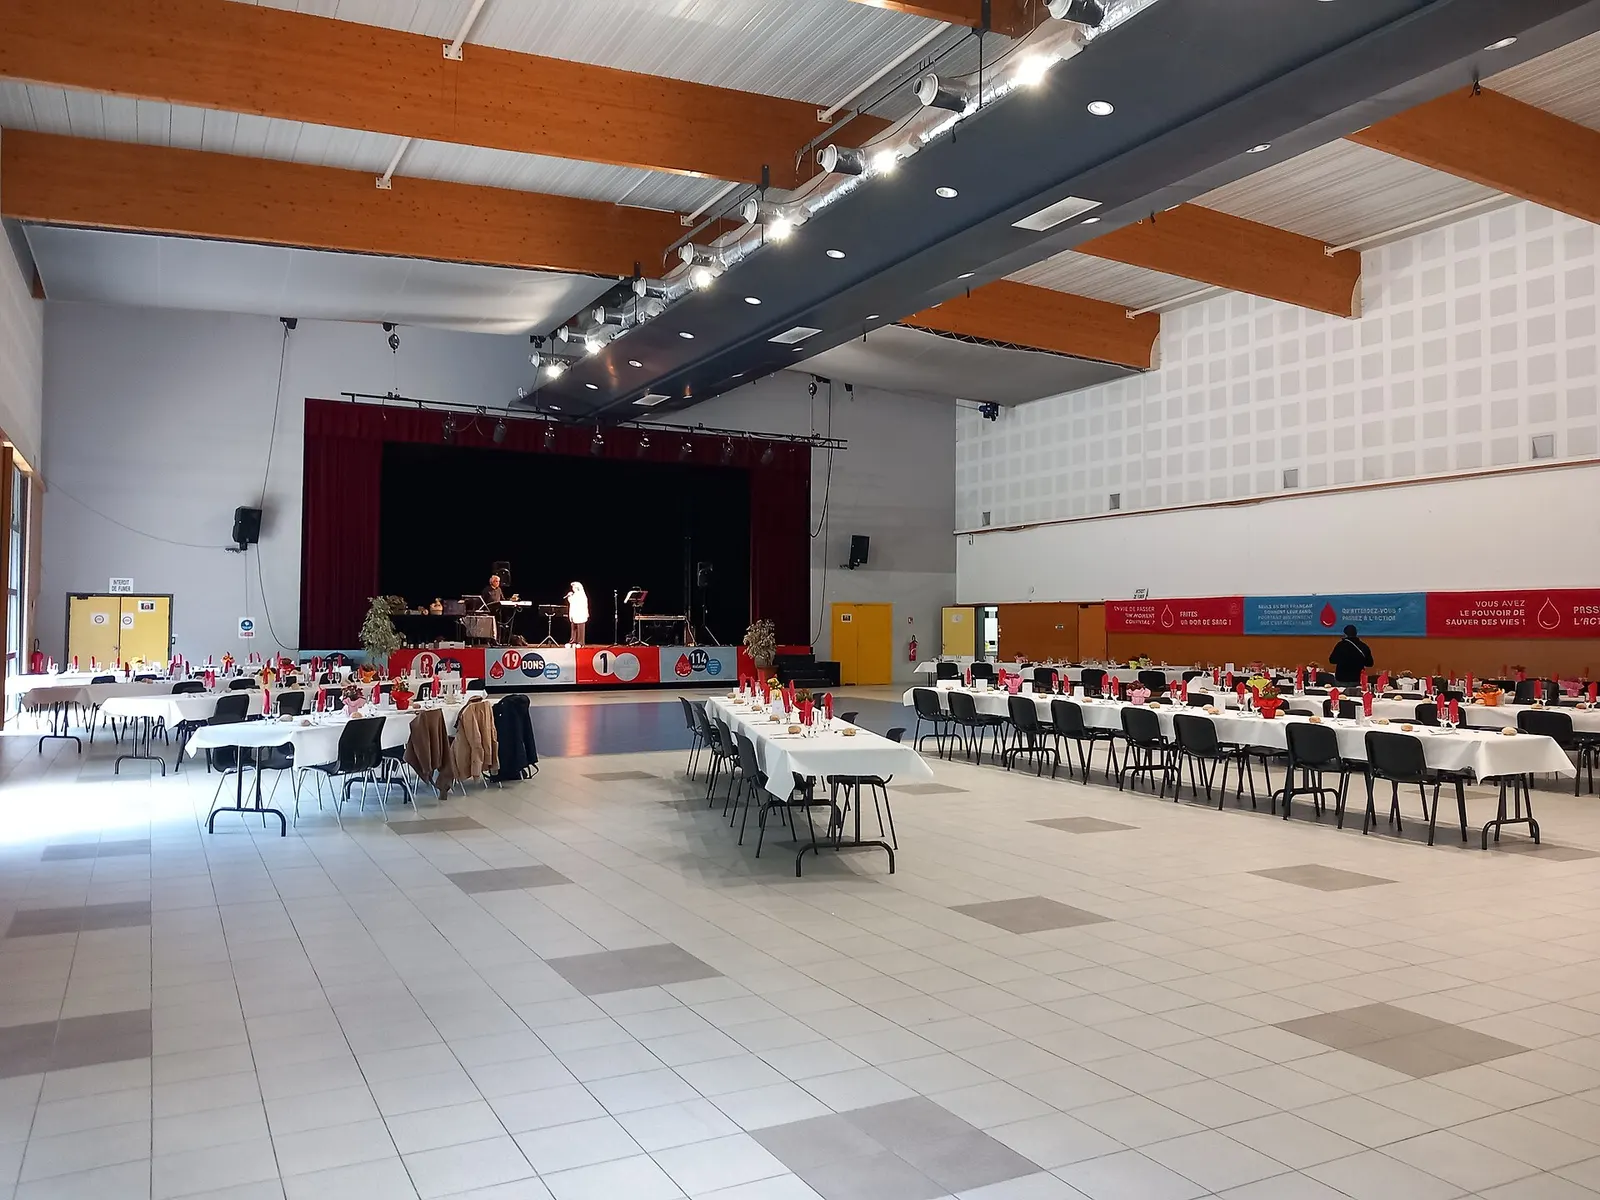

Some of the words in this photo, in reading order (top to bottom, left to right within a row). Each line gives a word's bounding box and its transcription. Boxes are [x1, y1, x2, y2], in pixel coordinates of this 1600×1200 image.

[1574, 606, 1600, 614] PASS
[504, 653, 519, 668] 19
[600, 652, 608, 674] 1
[690, 652, 706, 664] 114
[522, 660, 544, 670] DONS
